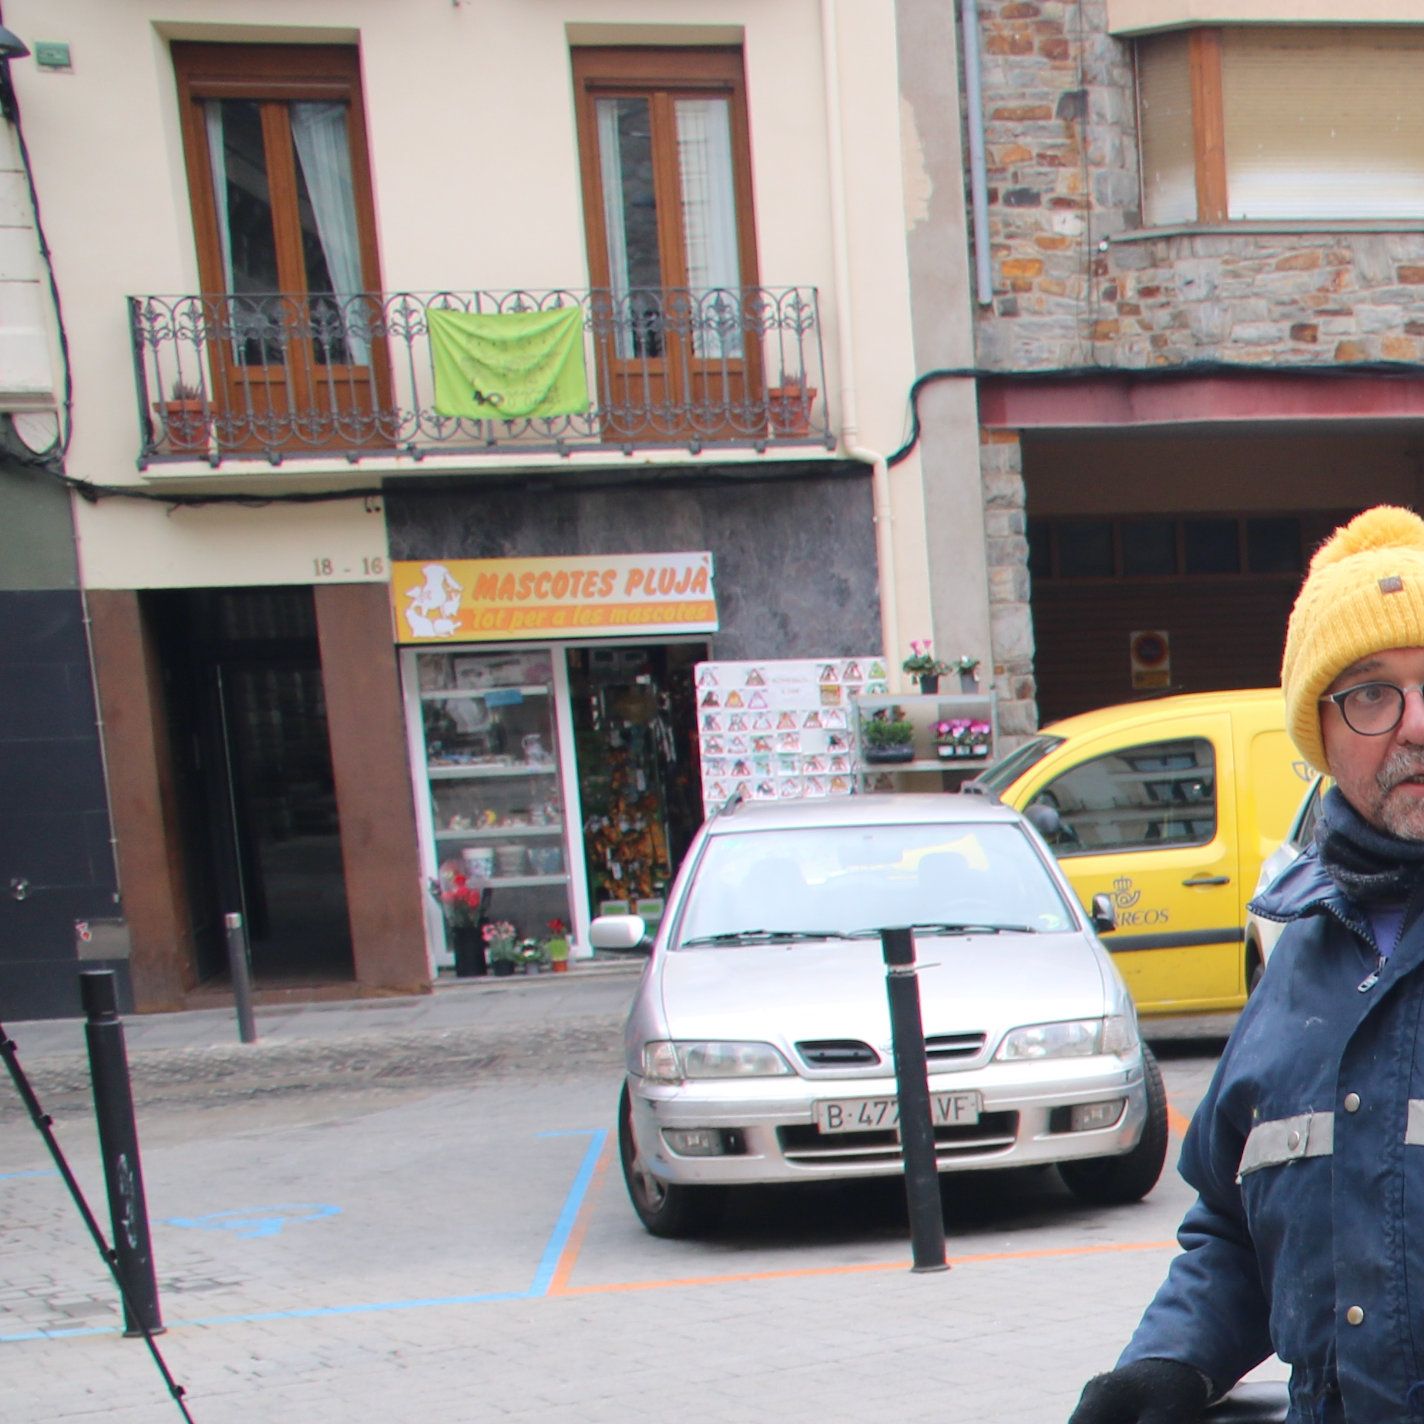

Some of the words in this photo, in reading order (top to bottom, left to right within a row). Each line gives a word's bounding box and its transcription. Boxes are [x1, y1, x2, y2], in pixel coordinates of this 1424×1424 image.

[313, 558, 333, 576] 18
[362, 556, 384, 576] 16
[472, 568, 618, 602] MASCOTES
[624, 555, 710, 597] PLUJÀ
[1115, 908, 1169, 928] REOS
